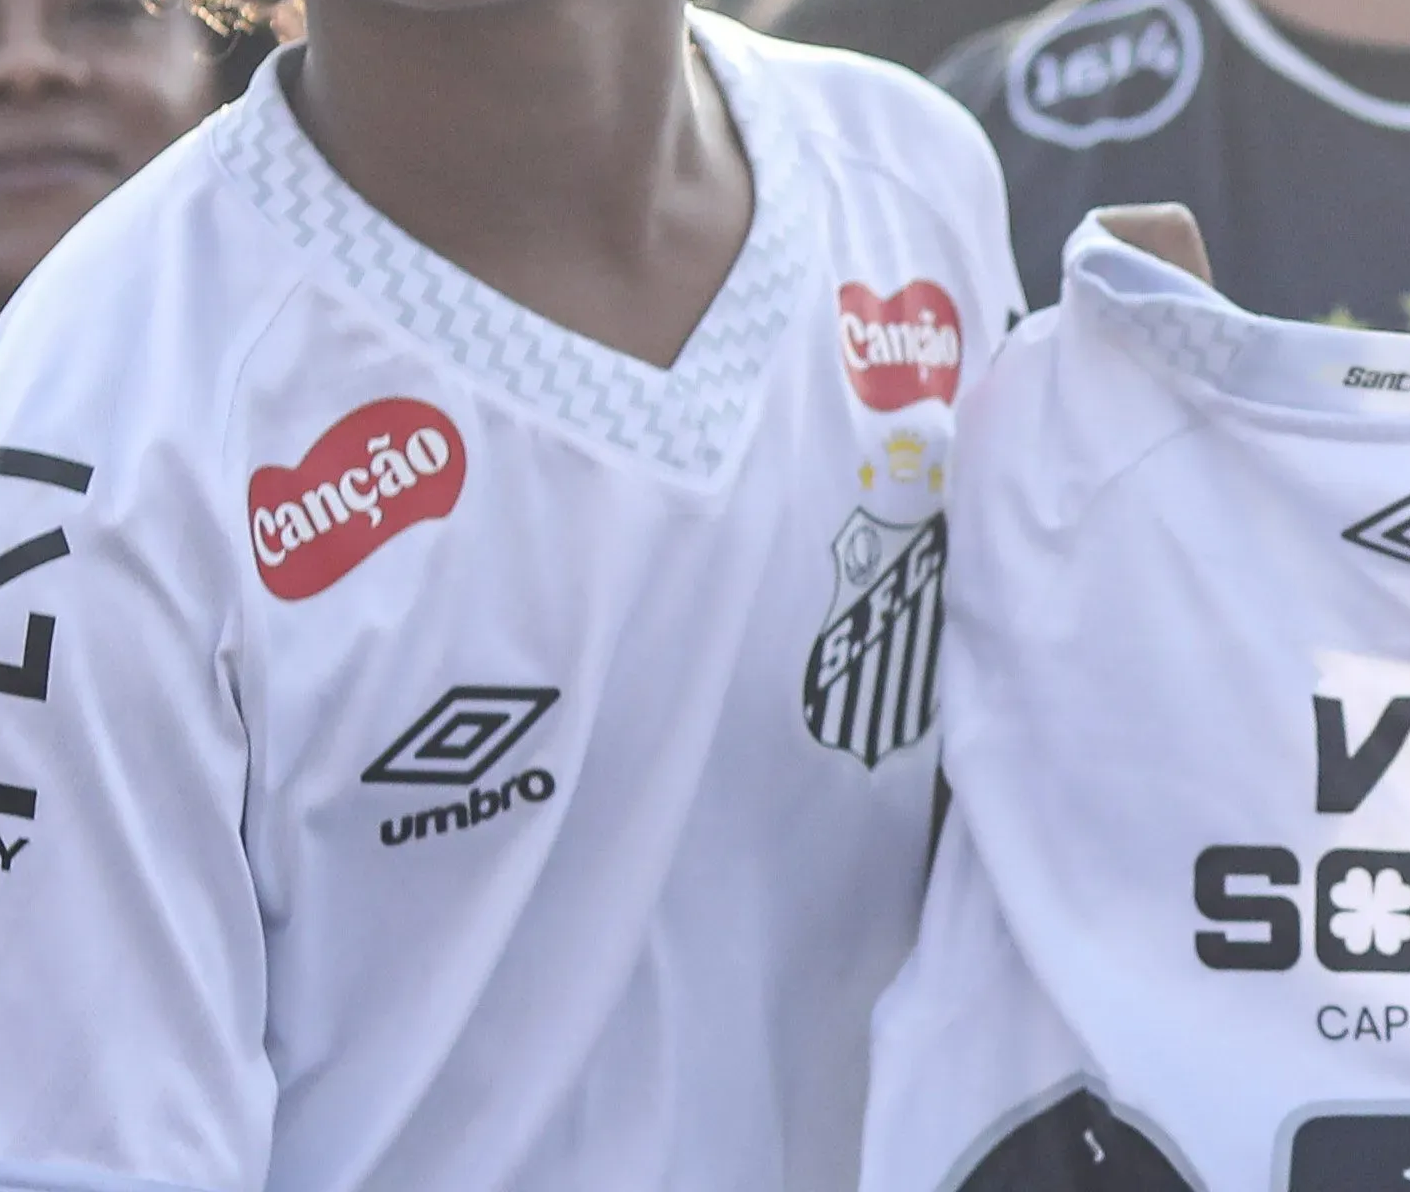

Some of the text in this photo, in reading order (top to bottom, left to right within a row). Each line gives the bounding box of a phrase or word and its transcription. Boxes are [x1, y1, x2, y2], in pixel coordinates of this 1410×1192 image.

[839, 308, 960, 383] Canção
[254, 422, 450, 567] Canção
[380, 768, 555, 847] umbro
